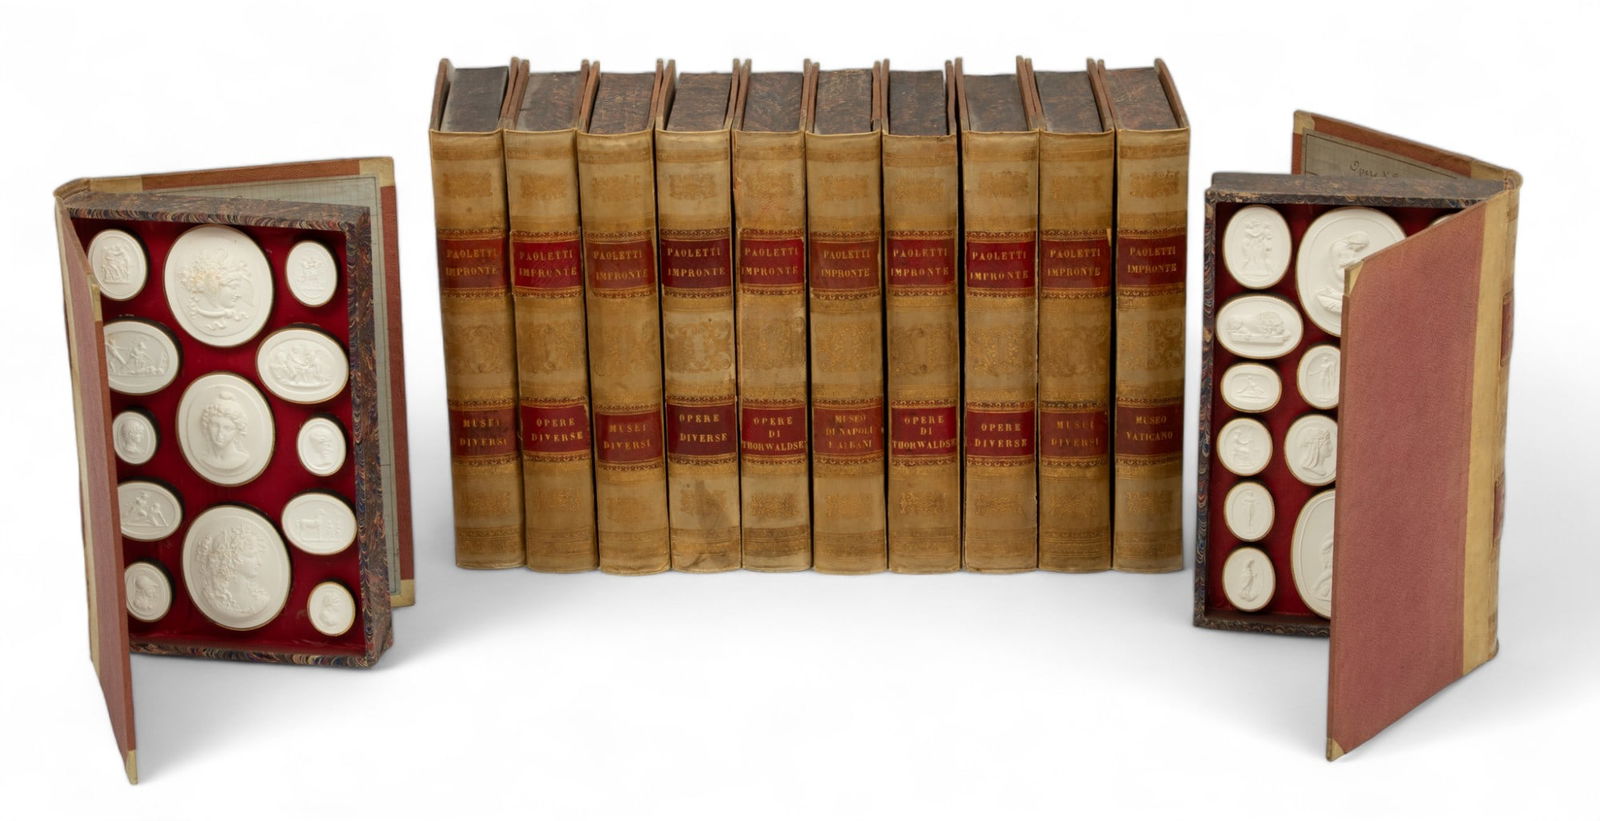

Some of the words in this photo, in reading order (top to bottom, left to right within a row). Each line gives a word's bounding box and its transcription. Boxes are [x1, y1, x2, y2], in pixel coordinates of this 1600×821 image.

[446, 248, 497, 259] PAOLETTI
[519, 250, 573, 261] PAOLETTI
[592, 249, 643, 260] PAOLETTI
[667, 247, 721, 257] PAOLETTI
[744, 247, 799, 257] PAOLETTI
[823, 249, 870, 259] PAOLETTI
[893, 247, 947, 257] PAOLETTI
[972, 250, 1026, 260] PAOLETTI
[1049, 247, 1101, 258] PAOLETTI
[1129, 246, 1176, 257] PAOLETTI
[446, 266, 498, 276] IMPRONTE
[519, 267, 577, 277] IMPRONTE
[668, 267, 726, 277] IMPRONTE
[741, 266, 799, 276] IMPRONTE
[821, 268, 870, 278] IMPRONTE
[890, 266, 949, 277] IMPRONTE
[1047, 267, 1101, 277] IMPRONTE
[1127, 263, 1177, 273] IMPRONTE
[595, 269, 648, 280] IMPRONTE
[970, 270, 1028, 280] IMPRONTE
[536, 417, 576, 427] OPERE
[679, 414, 720, 424] OPERE
[752, 416, 794, 426] OPERE
[904, 415, 945, 425] OPERE
[1135, 416, 1167, 424] MUSEO
[919, 426, 932, 436] DI
[981, 423, 1022, 432] OPERE
[531, 431, 584, 442] DIVERSE
[679, 432, 728, 443] DIVERSE
[768, 429, 781, 439] DI
[1126, 431, 1174, 441] VATICANO
[603, 439, 651, 450] DIVERSI
[974, 438, 1027, 448] DIVERSE
